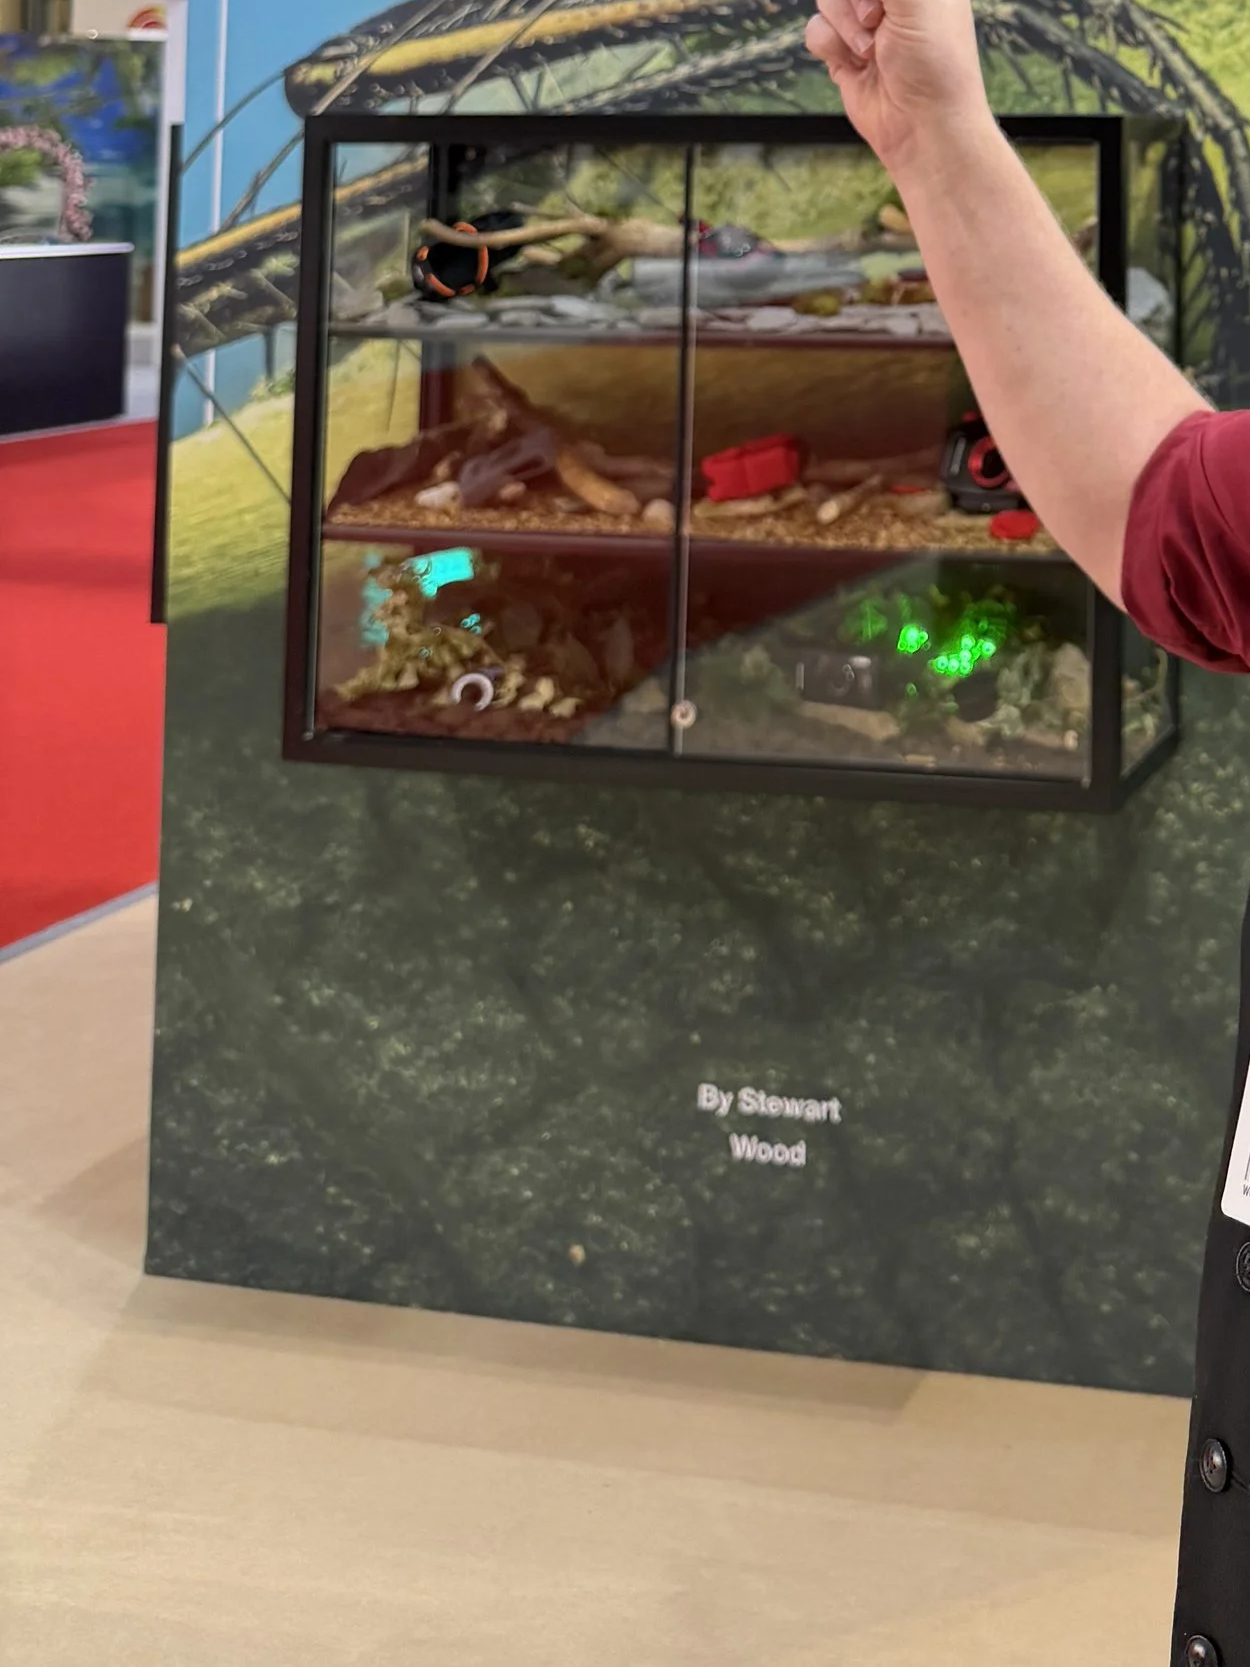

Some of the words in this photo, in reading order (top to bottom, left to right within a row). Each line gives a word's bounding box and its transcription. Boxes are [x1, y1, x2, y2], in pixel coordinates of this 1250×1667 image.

[697, 1083, 734, 1116] By
[737, 1086, 843, 1124] Stewart
[729, 1132, 807, 1168] Wood
